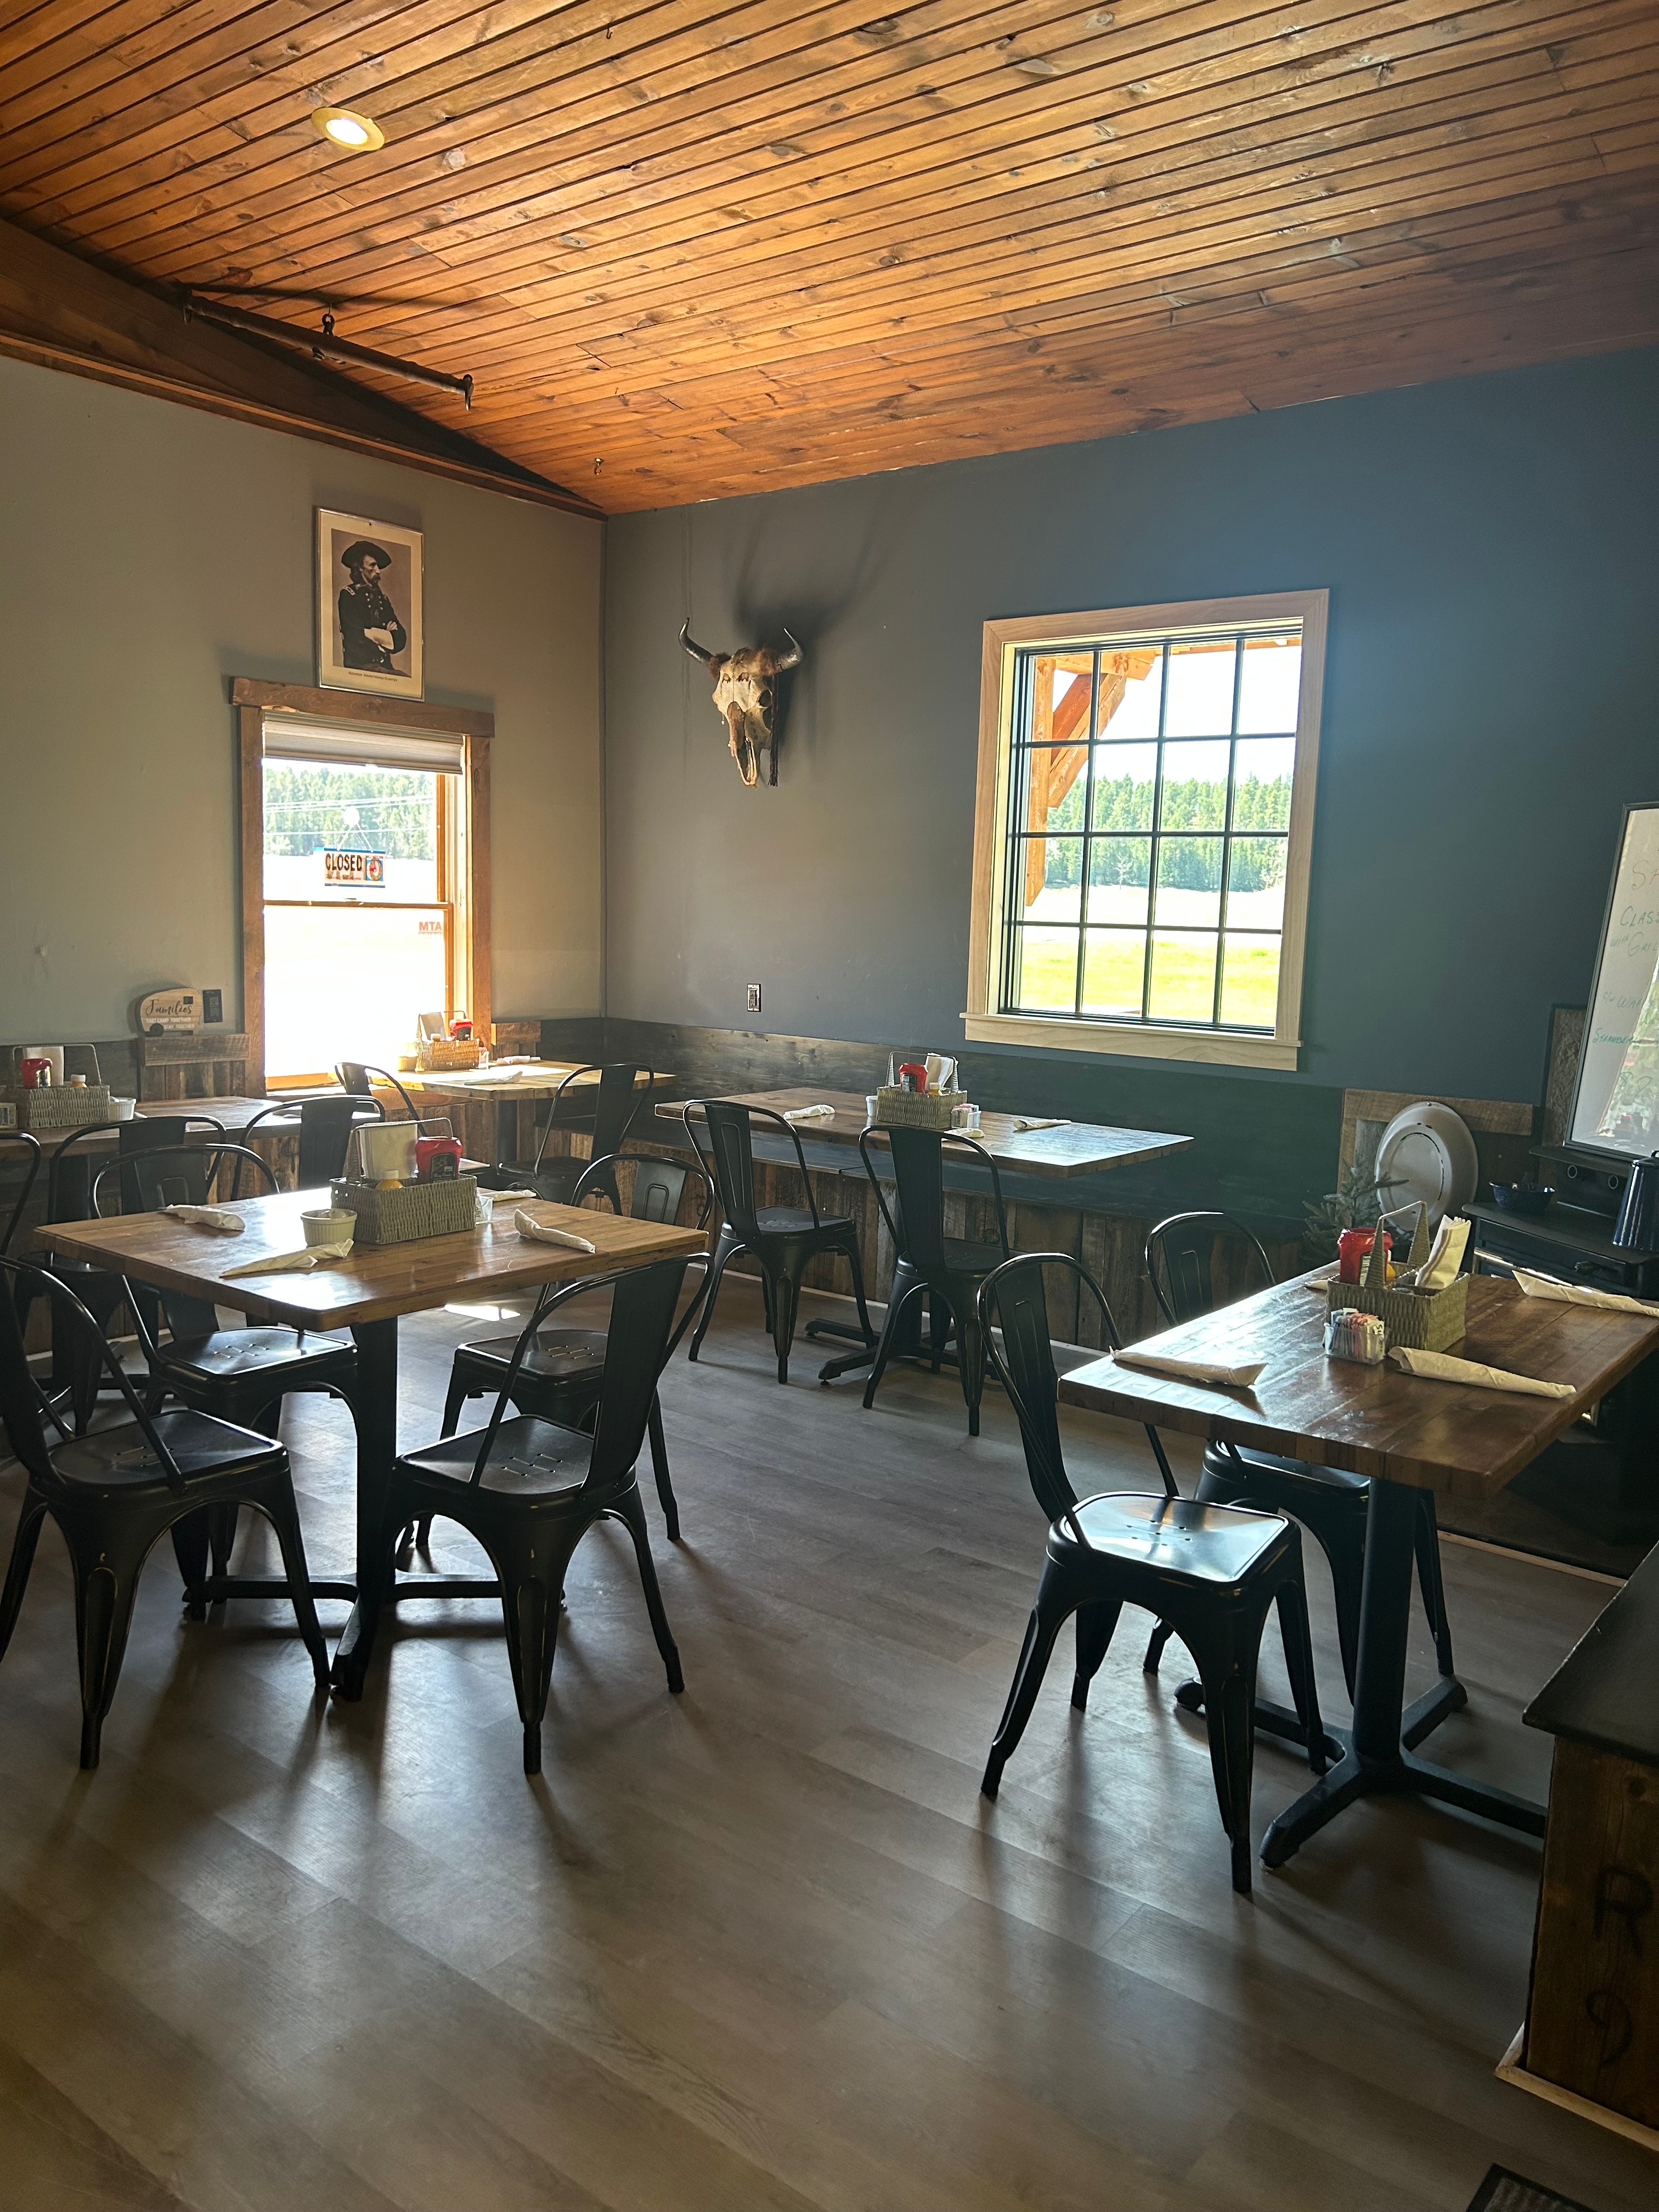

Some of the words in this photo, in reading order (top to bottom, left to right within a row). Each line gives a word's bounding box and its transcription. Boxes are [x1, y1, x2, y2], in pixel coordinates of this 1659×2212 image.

[325, 853, 362, 871] CLOSED
[419, 921, 442, 931] MTA
[145, 998, 192, 1016] Families
